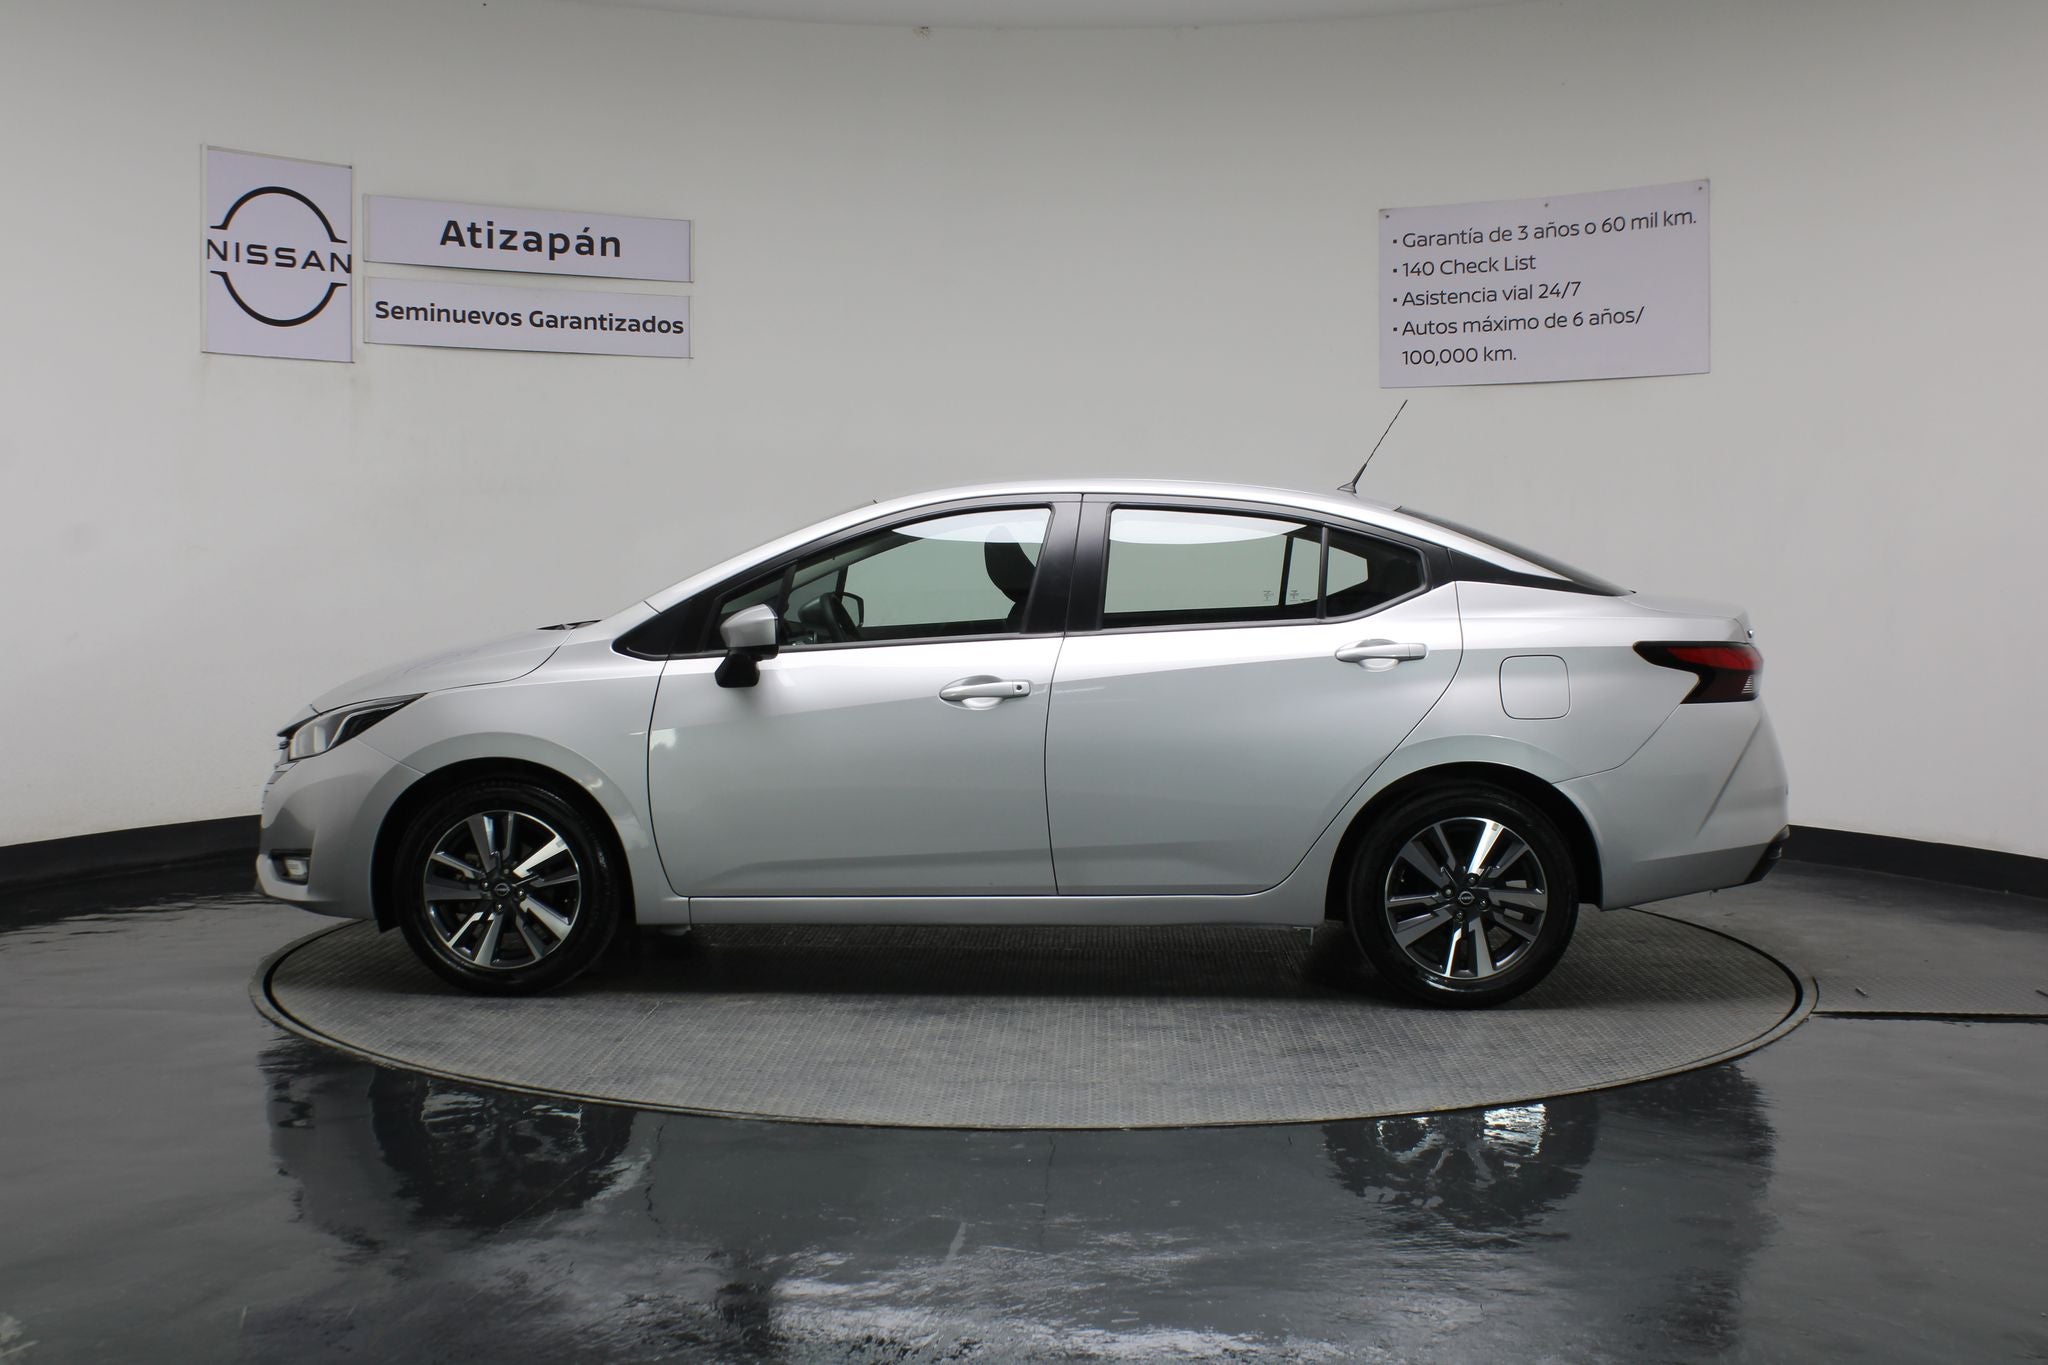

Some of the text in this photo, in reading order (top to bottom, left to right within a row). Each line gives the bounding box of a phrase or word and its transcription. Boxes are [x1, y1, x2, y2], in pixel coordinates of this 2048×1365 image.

[440, 219, 622, 261] Atizapán
[1402, 209, 1697, 248] Garantía de 3 años o 60 mil km.
[207, 238, 352, 274] NISSAN
[1402, 254, 1537, 277] 140 Check List
[1402, 281, 1582, 307] Asistencia vial 24/7
[375, 300, 685, 335] Seminuevos Garantizados
[1402, 306, 1646, 336] Autos máximo de 6 años/
[1402, 345, 1517, 368] 100,000 km.
